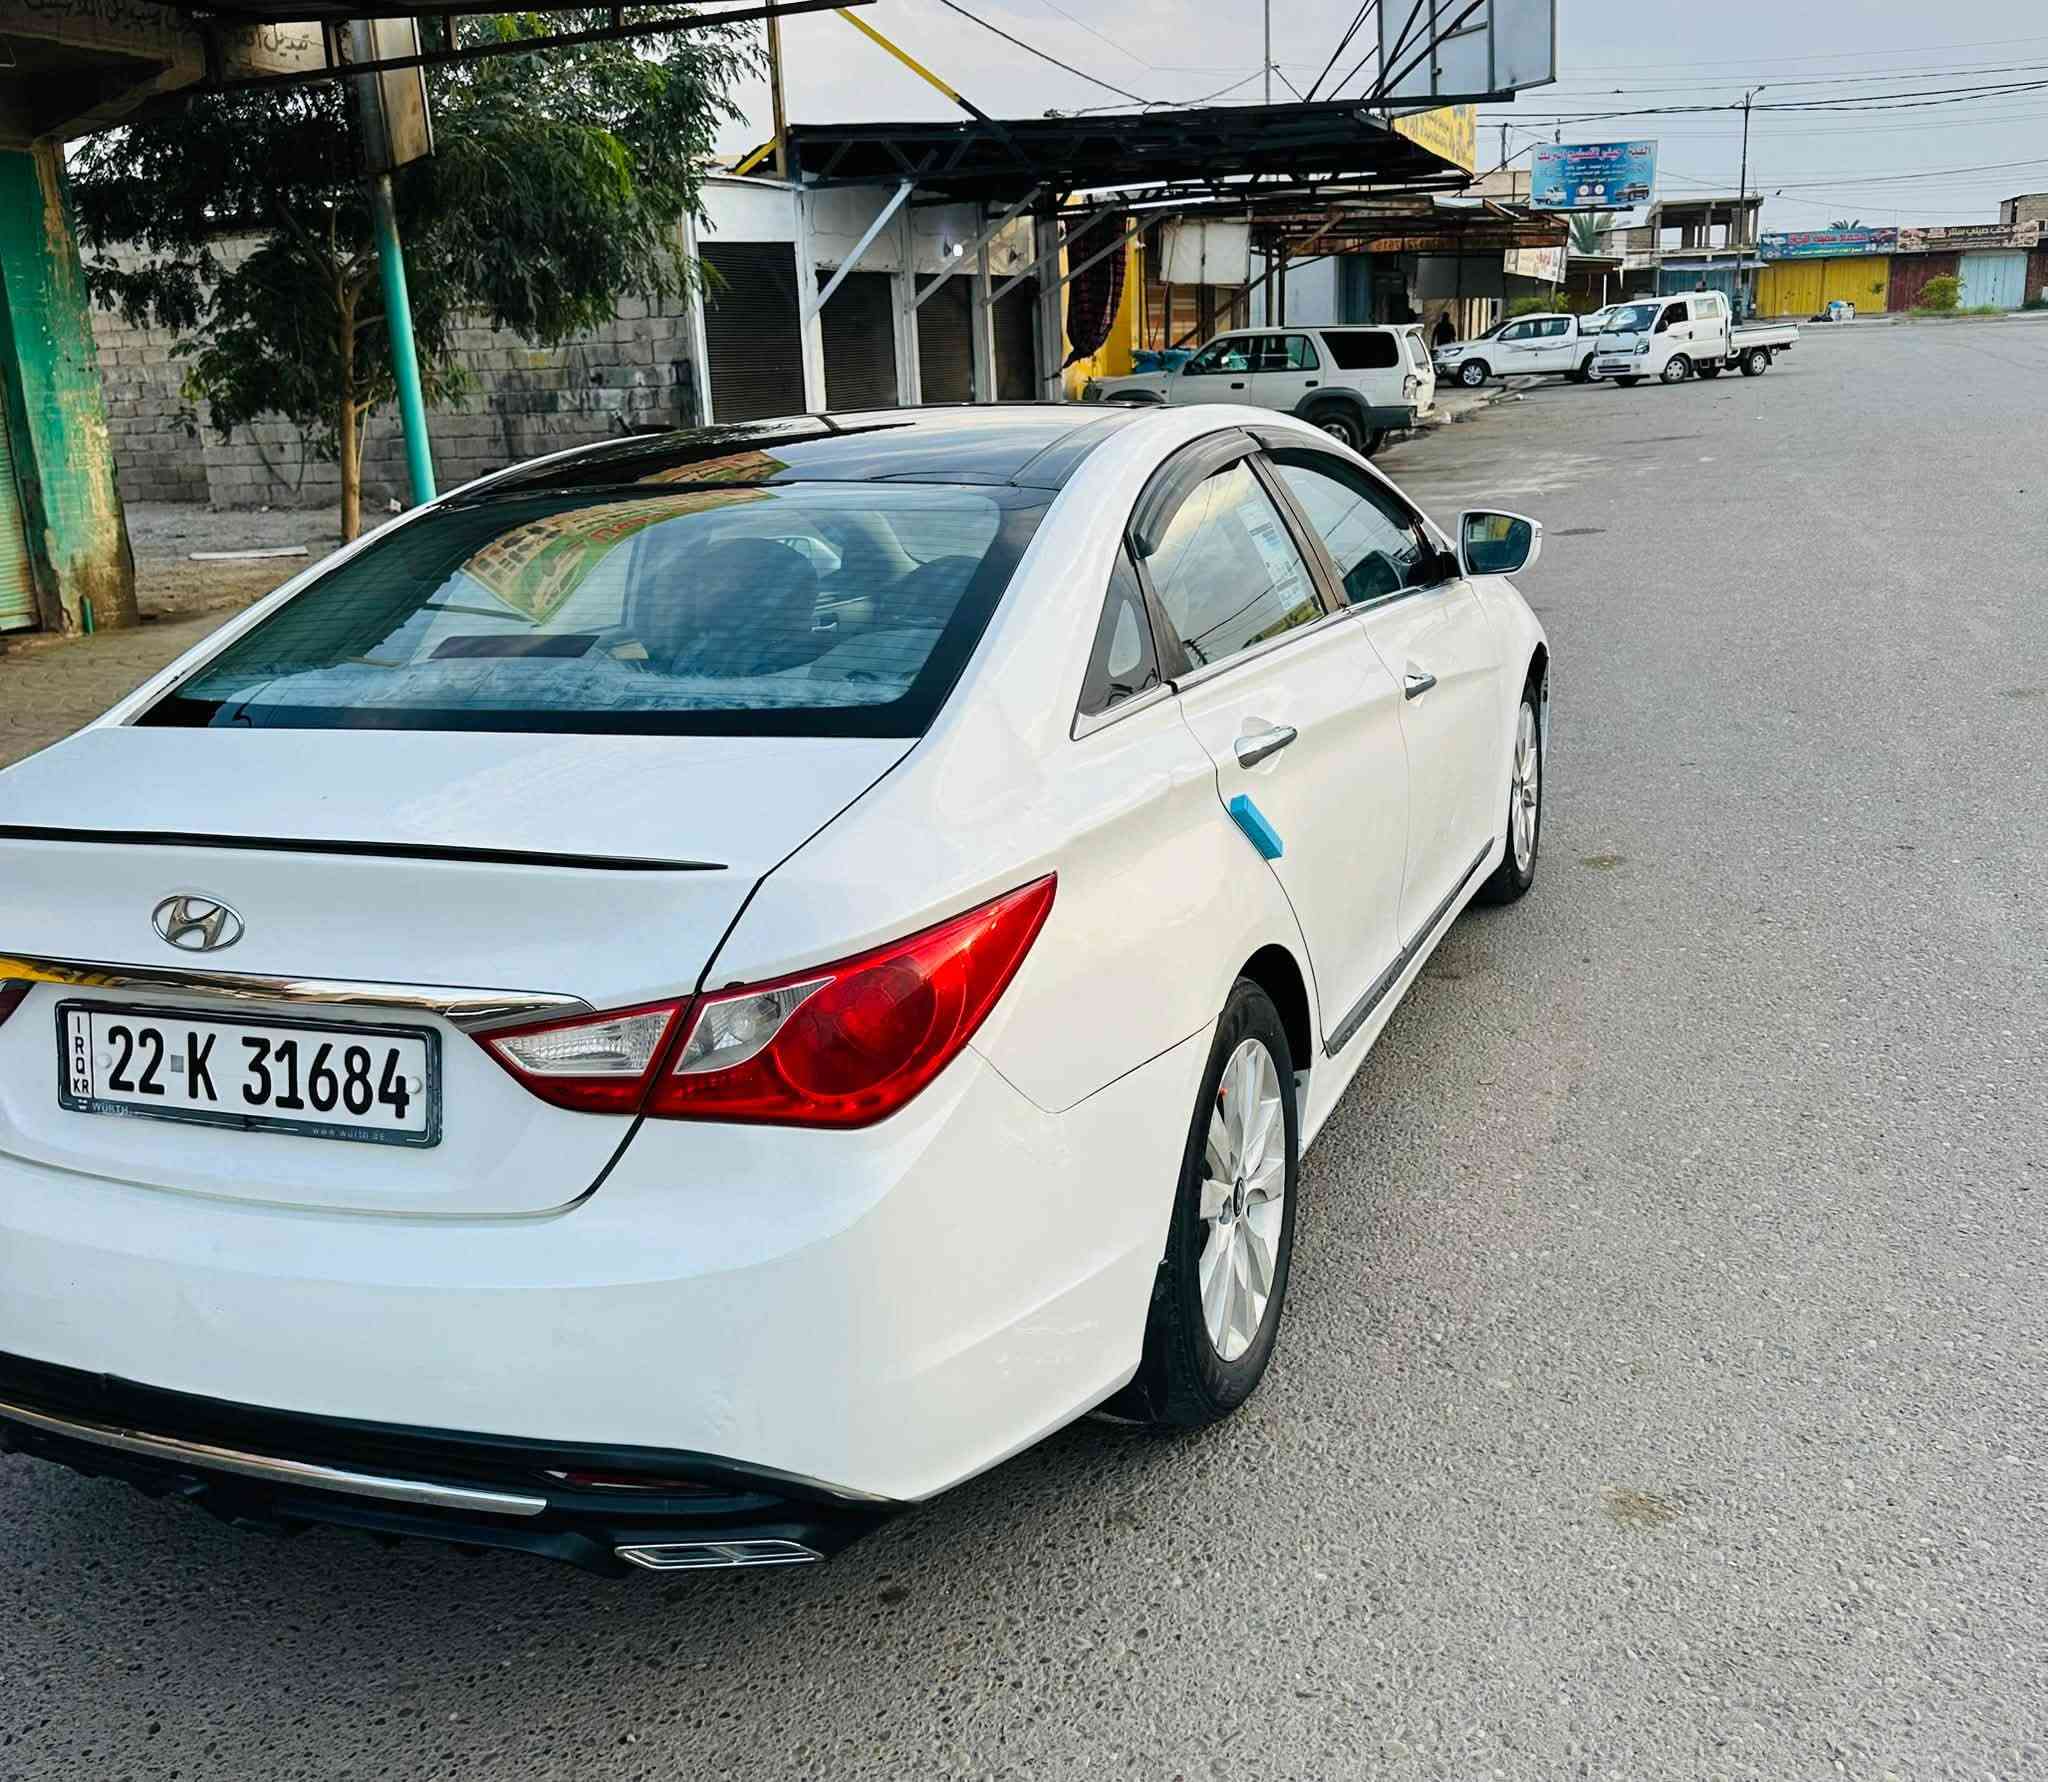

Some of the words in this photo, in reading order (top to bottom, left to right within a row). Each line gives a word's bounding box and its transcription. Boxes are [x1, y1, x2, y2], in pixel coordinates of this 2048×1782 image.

[74, 1015, 86, 1075] IRQ
[108, 1025, 165, 1095] 22
[187, 1031, 218, 1101] K
[242, 1036, 410, 1119] 31684
